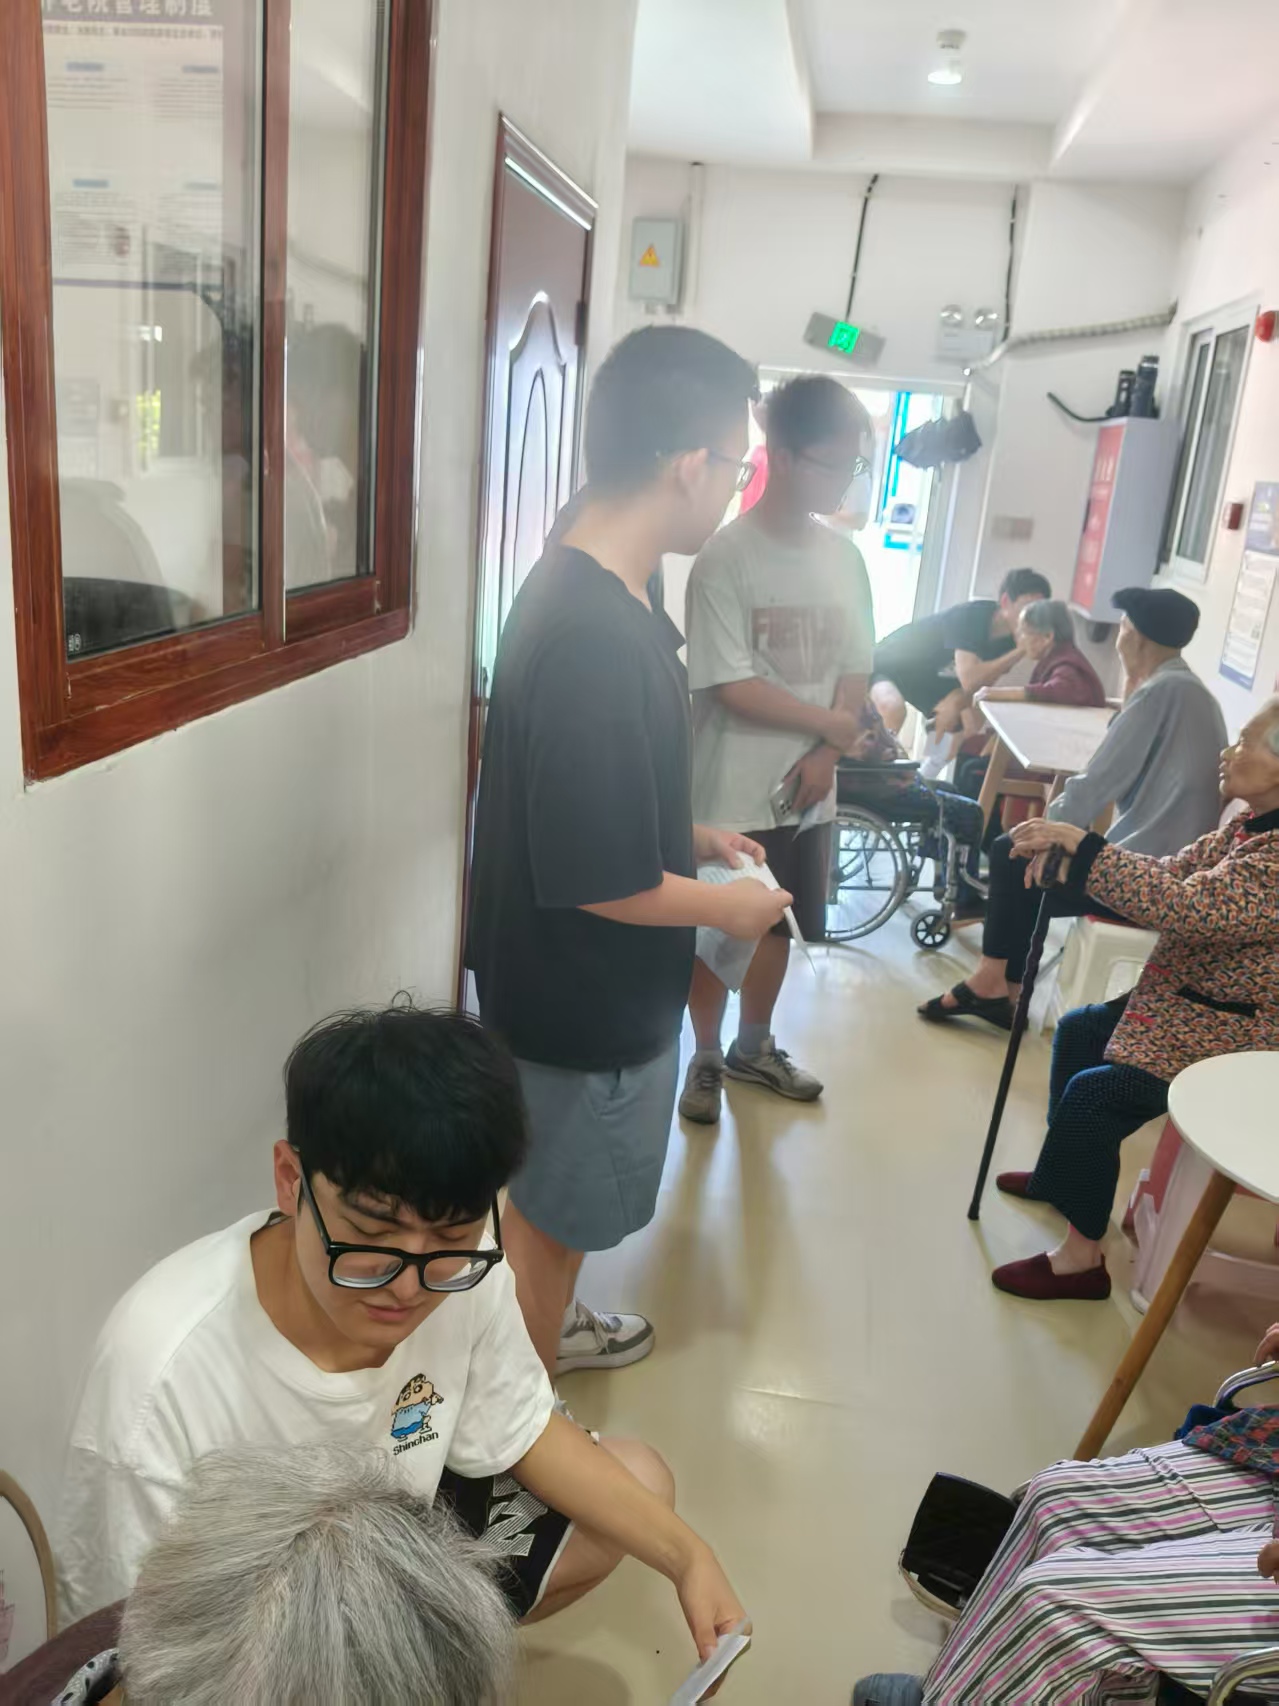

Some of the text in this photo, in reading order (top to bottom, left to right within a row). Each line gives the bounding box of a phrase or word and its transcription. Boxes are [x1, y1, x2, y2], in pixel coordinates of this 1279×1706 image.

[44, 0, 213, 16] 老院管理制度
[393, 1432, 439, 1456] Shinchan
